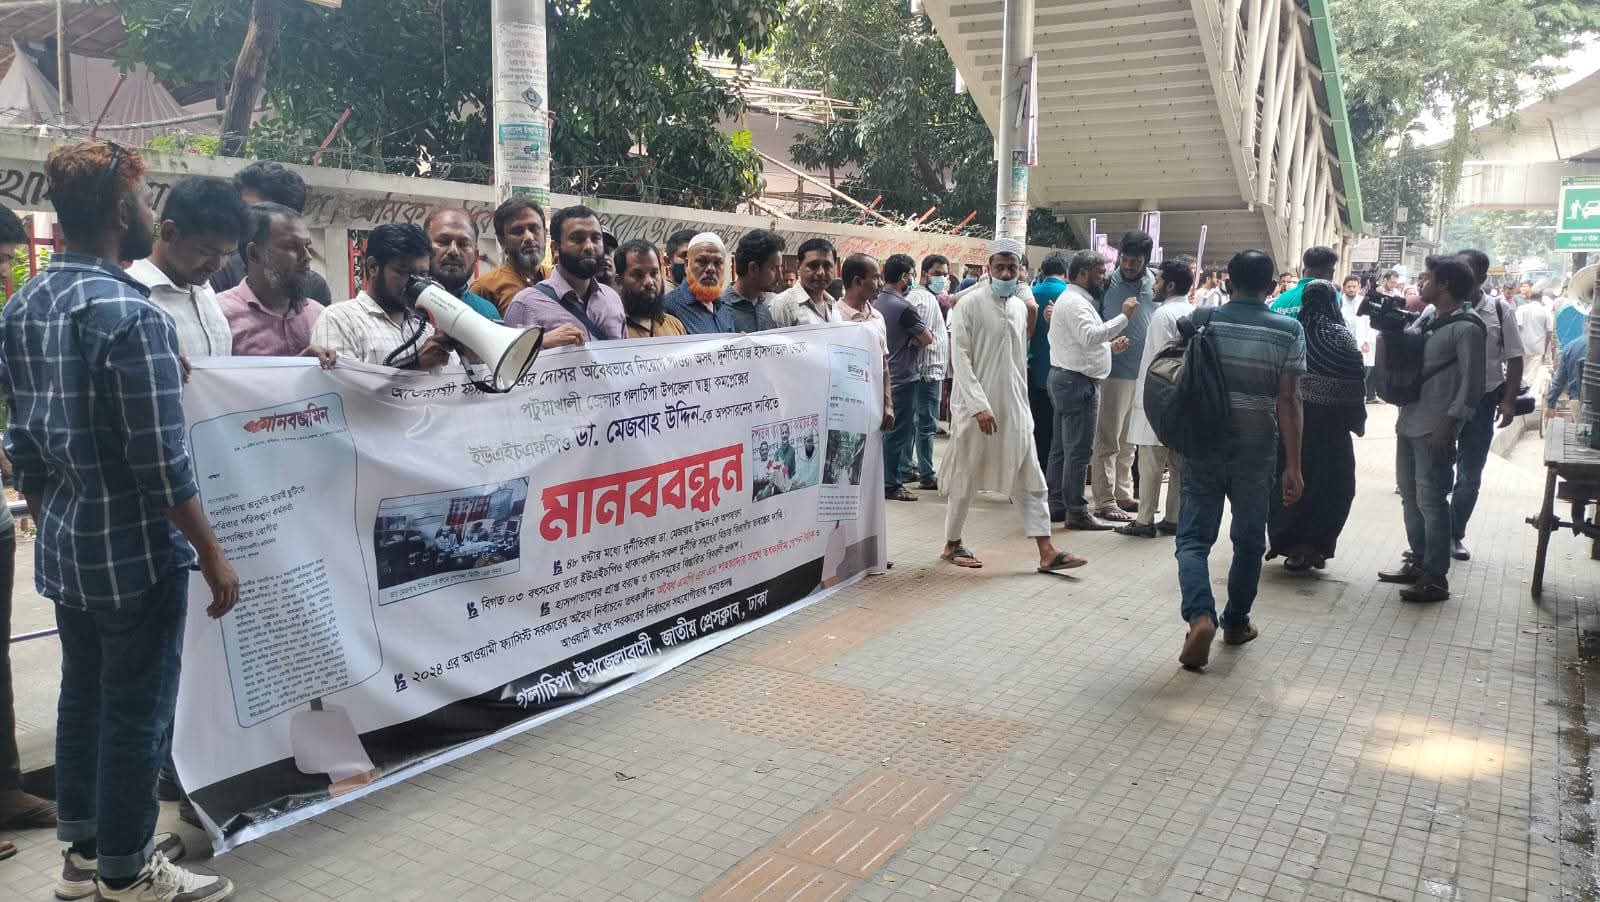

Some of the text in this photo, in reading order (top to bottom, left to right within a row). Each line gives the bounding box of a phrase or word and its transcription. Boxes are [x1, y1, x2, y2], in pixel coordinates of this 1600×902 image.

[540, 367, 576, 385] দোসর
[580, 362, 634, 380] অবৈধভাবে
[256, 403, 329, 433] মানবজমিন
[520, 392, 582, 422] পটুয়াখালী
[587, 392, 621, 410] জেলার
[624, 383, 657, 404] গলাচিপা
[660, 380, 693, 397] উপজেলা
[469, 434, 571, 467] ইউএইচএফপিও
[607, 413, 661, 443] মেজবাহ
[754, 395, 780, 412] দাবিতে
[540, 443, 744, 542] মানববন্ধন
[566, 558, 579, 570] ৪৮
[603, 546, 621, 558] মধ্যে
[670, 525, 694, 540] মেজবাহ
[481, 595, 507, 612] বিগত
[508, 592, 525, 603] ০৩
[528, 581, 561, 599] বৎসরের
[563, 575, 578, 589] তার
[555, 588, 602, 609] হাসপাতালের
[412, 665, 442, 683] ২০২৪
[446, 656, 459, 671] এর
[461, 639, 498, 665] আওয়ামী
[499, 628, 532, 652] ফ্যাসিস্ট
[533, 617, 567, 637] সরকারের
[570, 608, 592, 624] অবৈধ
[561, 627, 590, 648] আওয়ামী
[592, 622, 612, 635] অবৈধ
[613, 610, 644, 628] সরকারের
[646, 600, 671, 617] নির্বাচনে
[516, 670, 573, 709] গলাচিপা
[660, 615, 698, 648] জাতীয়
[747, 590, 769, 612] ঢাকা
